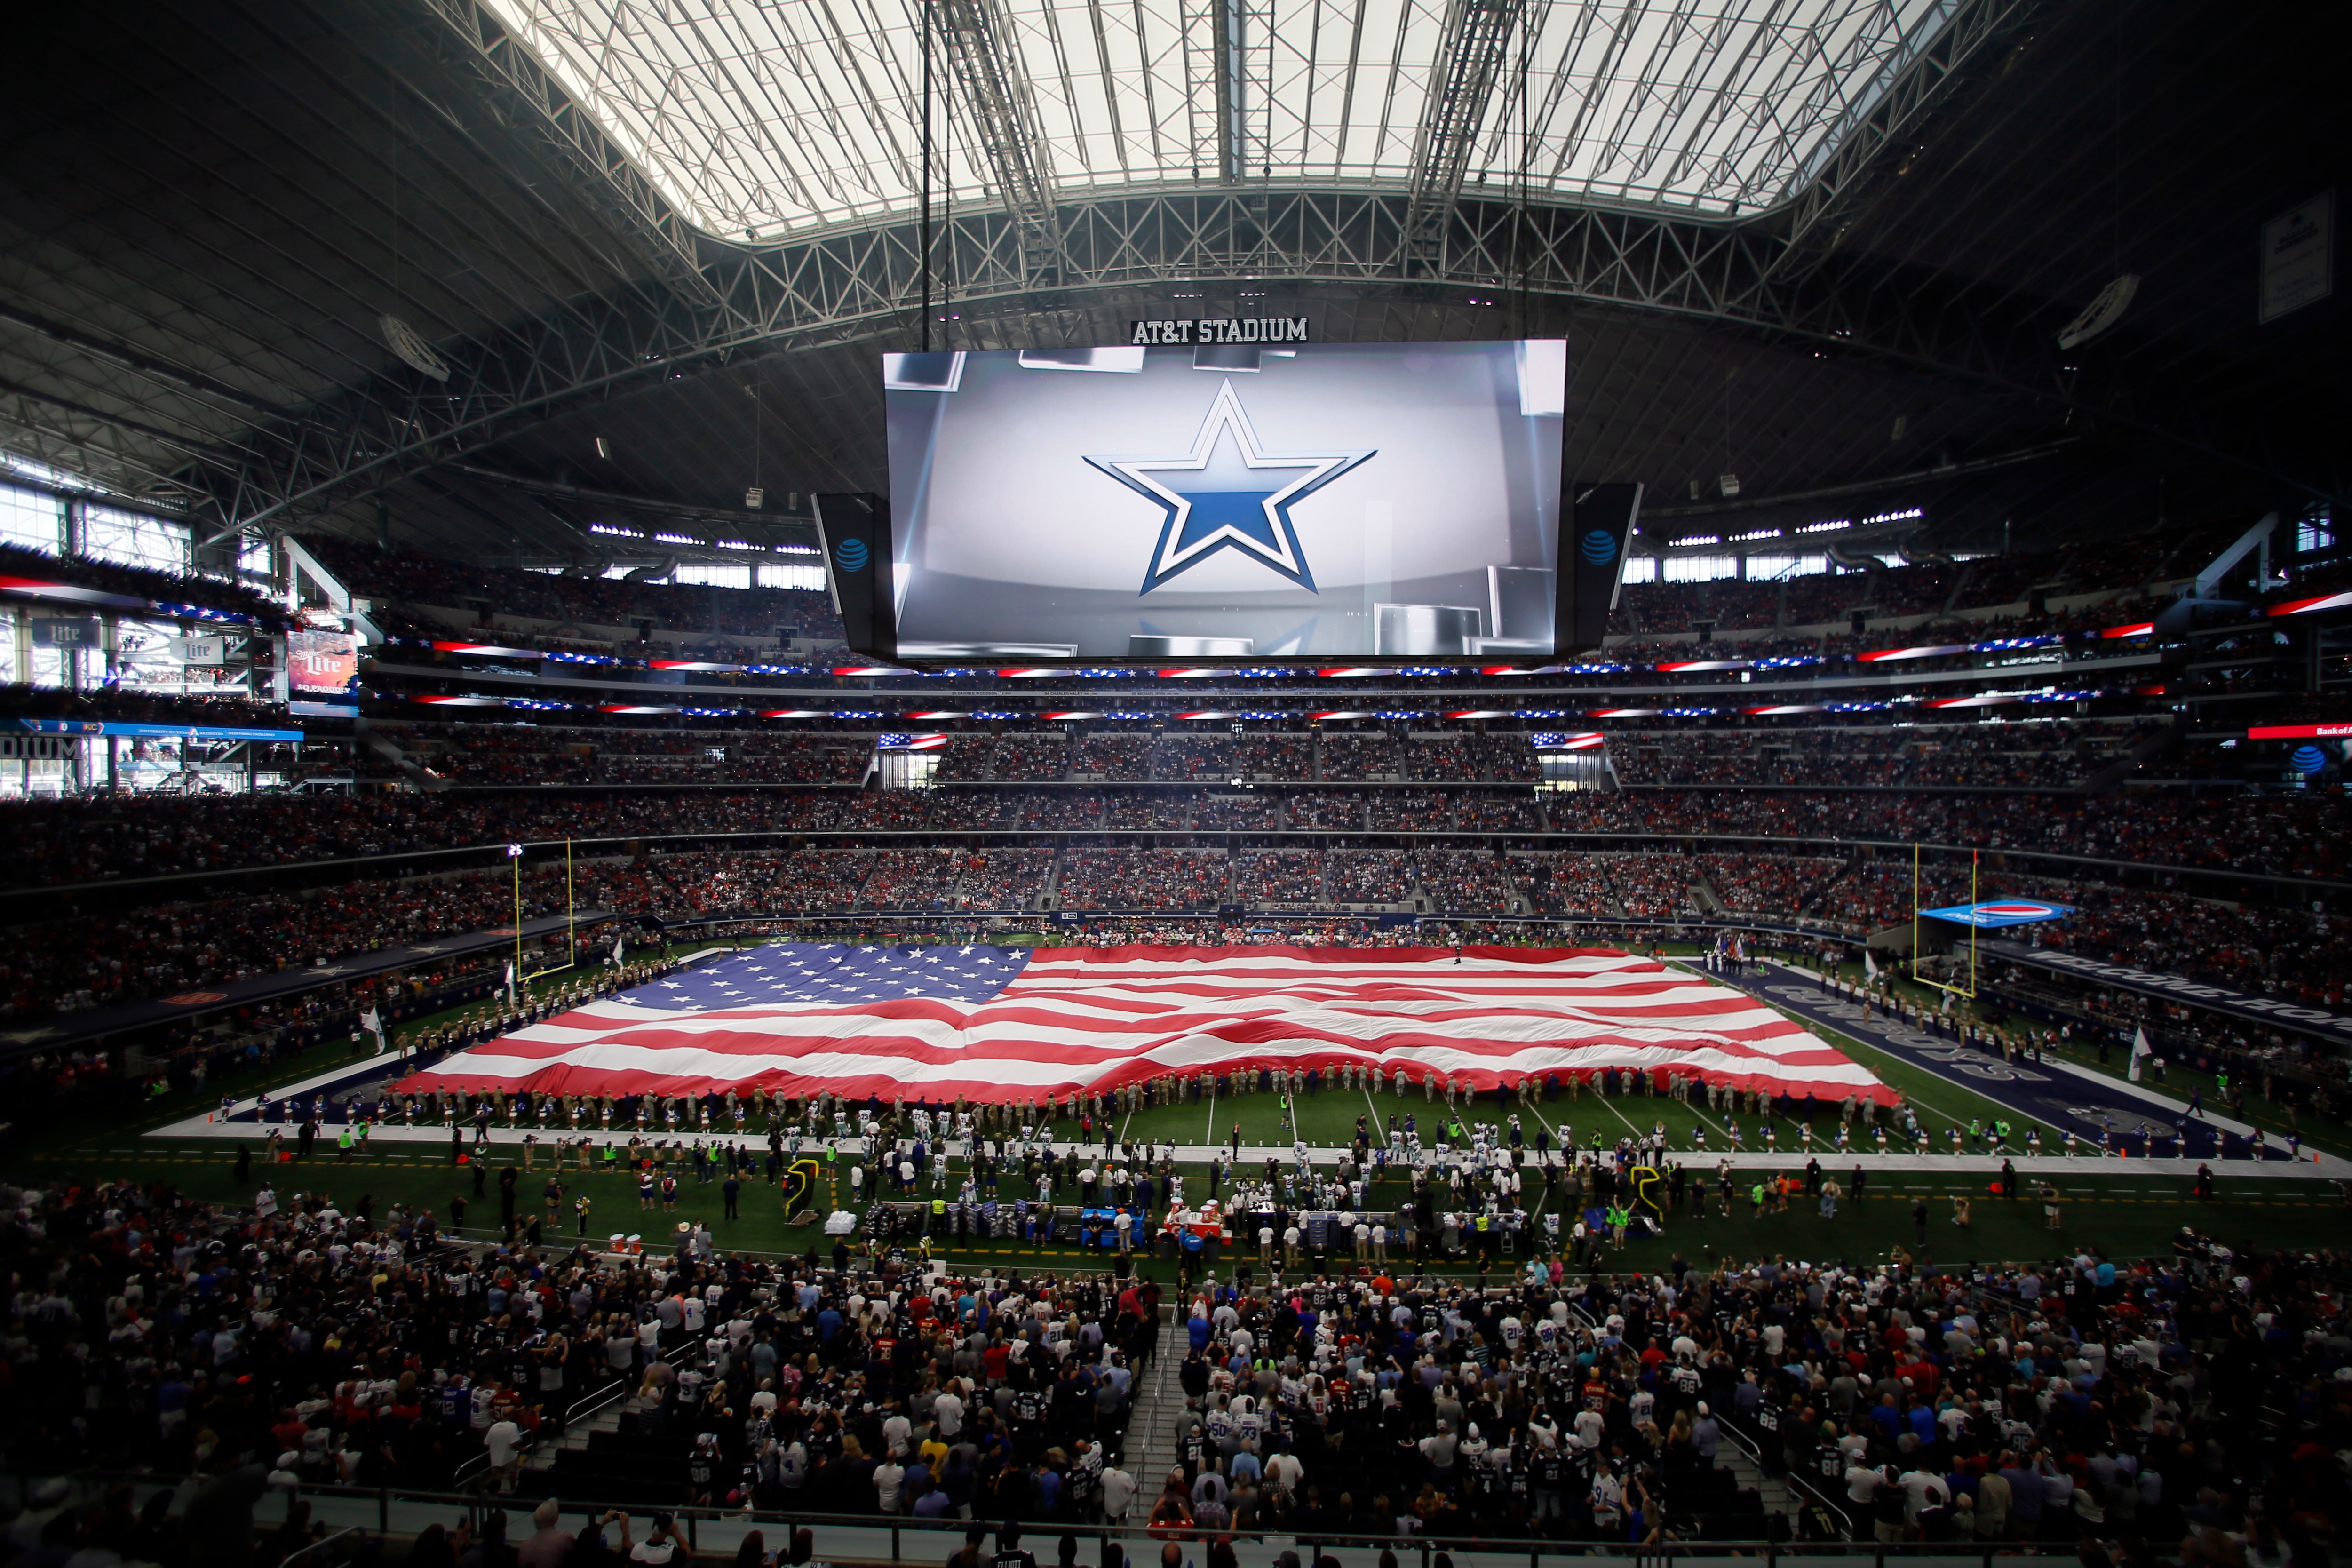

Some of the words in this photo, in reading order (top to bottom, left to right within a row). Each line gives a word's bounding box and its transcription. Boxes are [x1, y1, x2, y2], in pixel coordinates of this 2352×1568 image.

[1133, 320, 1192, 344] AT&T
[1199, 318, 1307, 342] STADIUM
[51, 626, 80, 645] Lite
[185, 642, 211, 660] Lite
[296, 650, 321, 660] Miller
[307, 656, 342, 676] Lite
[1313, 1295, 1327, 1305] 82
[1336, 1293, 1347, 1303] 82
[686, 1307, 692, 1318] 4
[1037, 1312, 1046, 1320] 10
[1050, 1331, 1061, 1341] 21
[1507, 1328, 1518, 1340] 21
[1679, 1378, 1696, 1394] 88
[1020, 1405, 1036, 1420] 82
[1758, 1412, 1779, 1432] 82
[1212, 1423, 1226, 1437] 50
[1188, 1446, 1203, 1462] 21
[784, 1459, 794, 1473] 4
[1073, 1481, 1088, 1501] 82
[1483, 1480, 1491, 1494] 4
